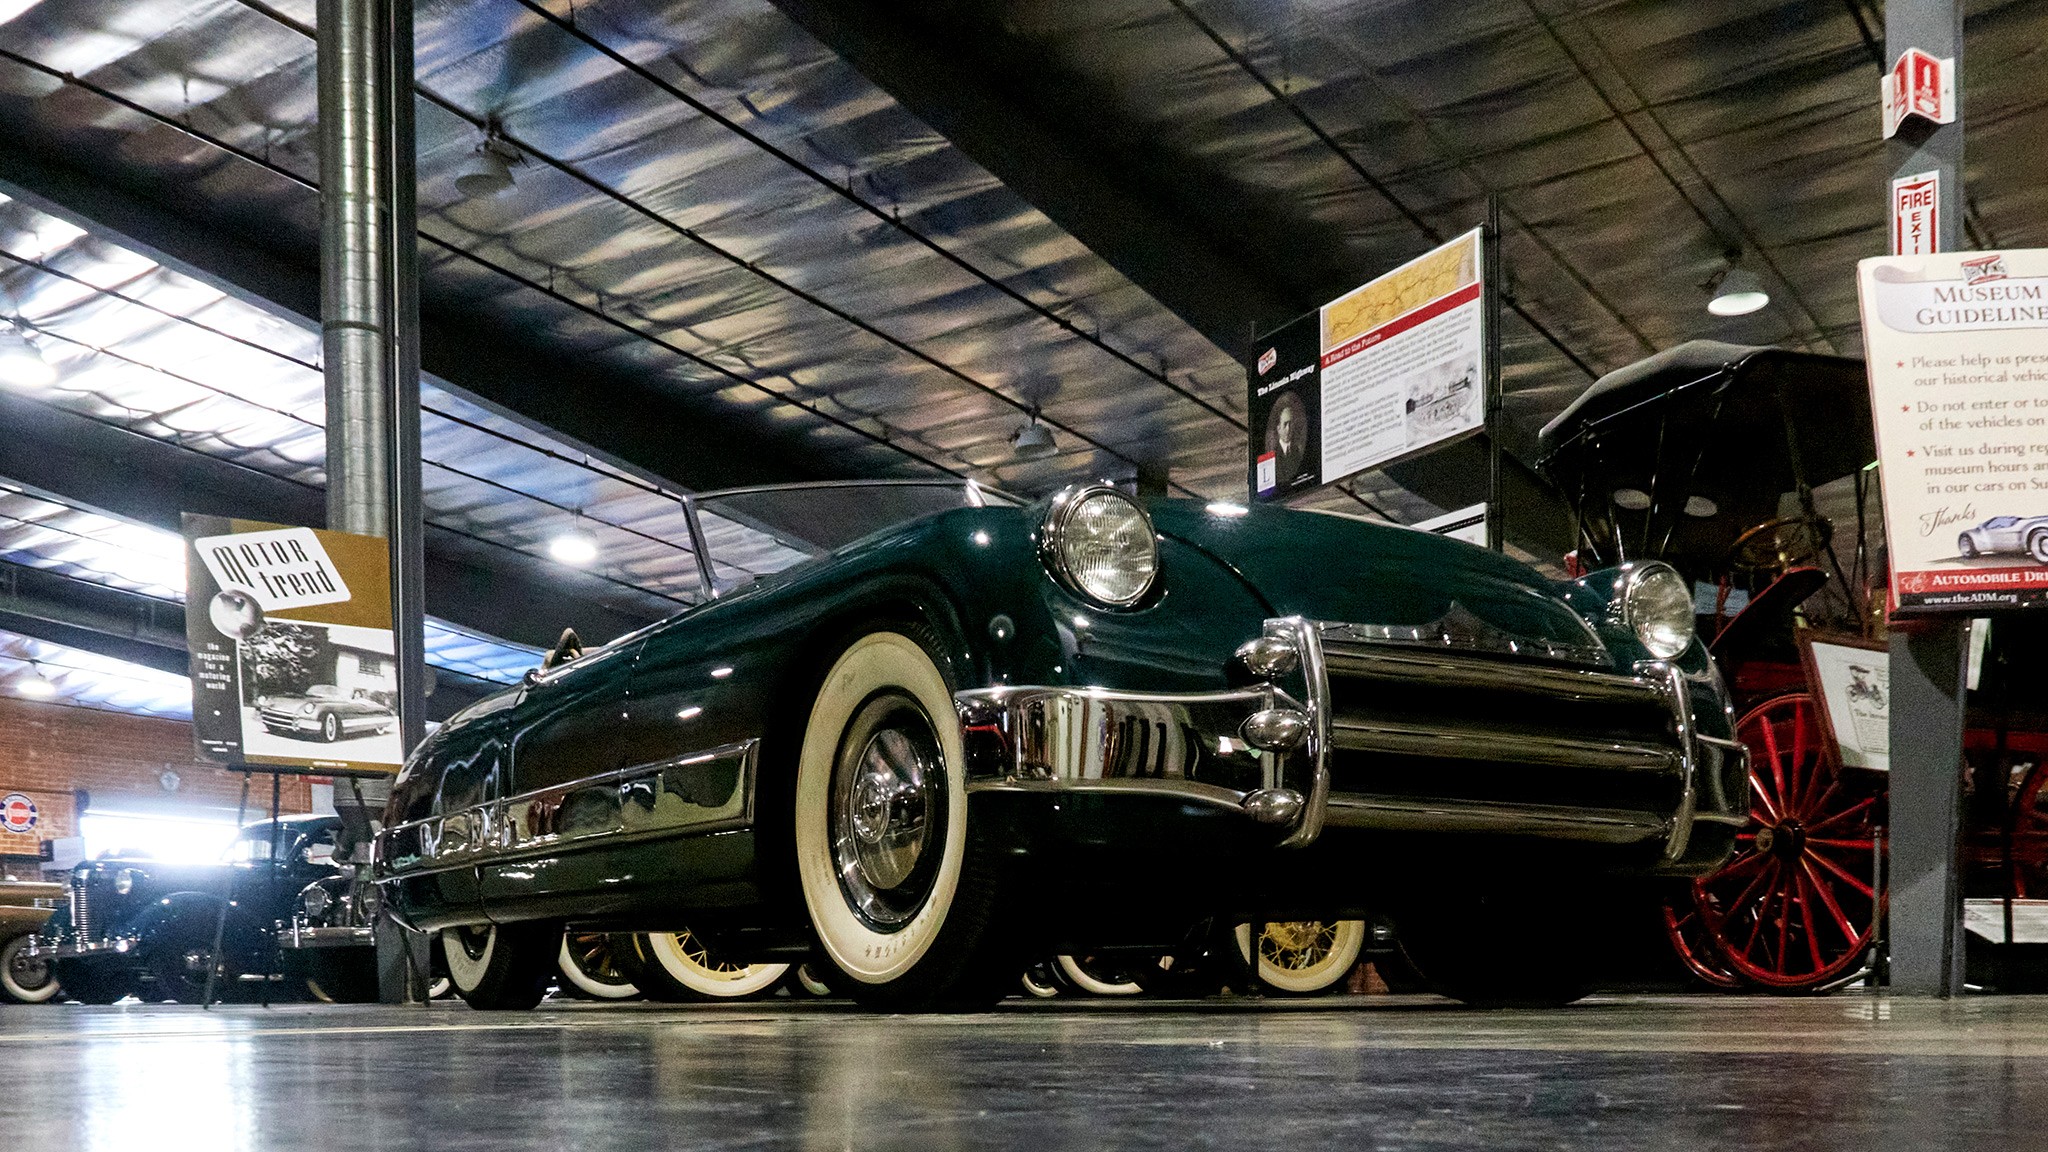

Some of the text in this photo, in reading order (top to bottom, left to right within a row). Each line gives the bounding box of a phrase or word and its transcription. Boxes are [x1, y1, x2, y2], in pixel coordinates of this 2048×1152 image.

[1901, 189, 1932, 211] FIRE
[1934, 285, 2042, 304] MUSEUM
[1916, 307, 2048, 326] GUIDELINE
[1912, 356, 1957, 369] Please
[1961, 353, 1991, 368] help
[1996, 355, 2011, 365] us
[1914, 377, 1938, 386] our
[1943, 370, 2008, 385] historical
[1917, 401, 1938, 413] Do
[1943, 400, 1966, 412] not
[1971, 399, 2009, 410] enter
[2013, 399, 2029, 409] or
[1919, 415, 2045, 431] of the vehicles on
[1923, 445, 1957, 457] Visit
[1959, 446, 1974, 456] us
[1978, 442, 2026, 457] during
[1924, 466, 1984, 476] museum
[1988, 461, 2029, 474] hours
[1927, 482, 1940, 494] in
[1945, 483, 1970, 493] our
[1974, 482, 2004, 492] cars
[2008, 481, 2026, 491] on
[1919, 503, 1976, 537] Thanks
[257, 560, 337, 599] trend
[1932, 572, 2021, 586] AUTOMOBILE
[1923, 593, 2017, 605] www.theADM.org
[207, 642, 219, 651] the
[205, 661, 216, 670] for
